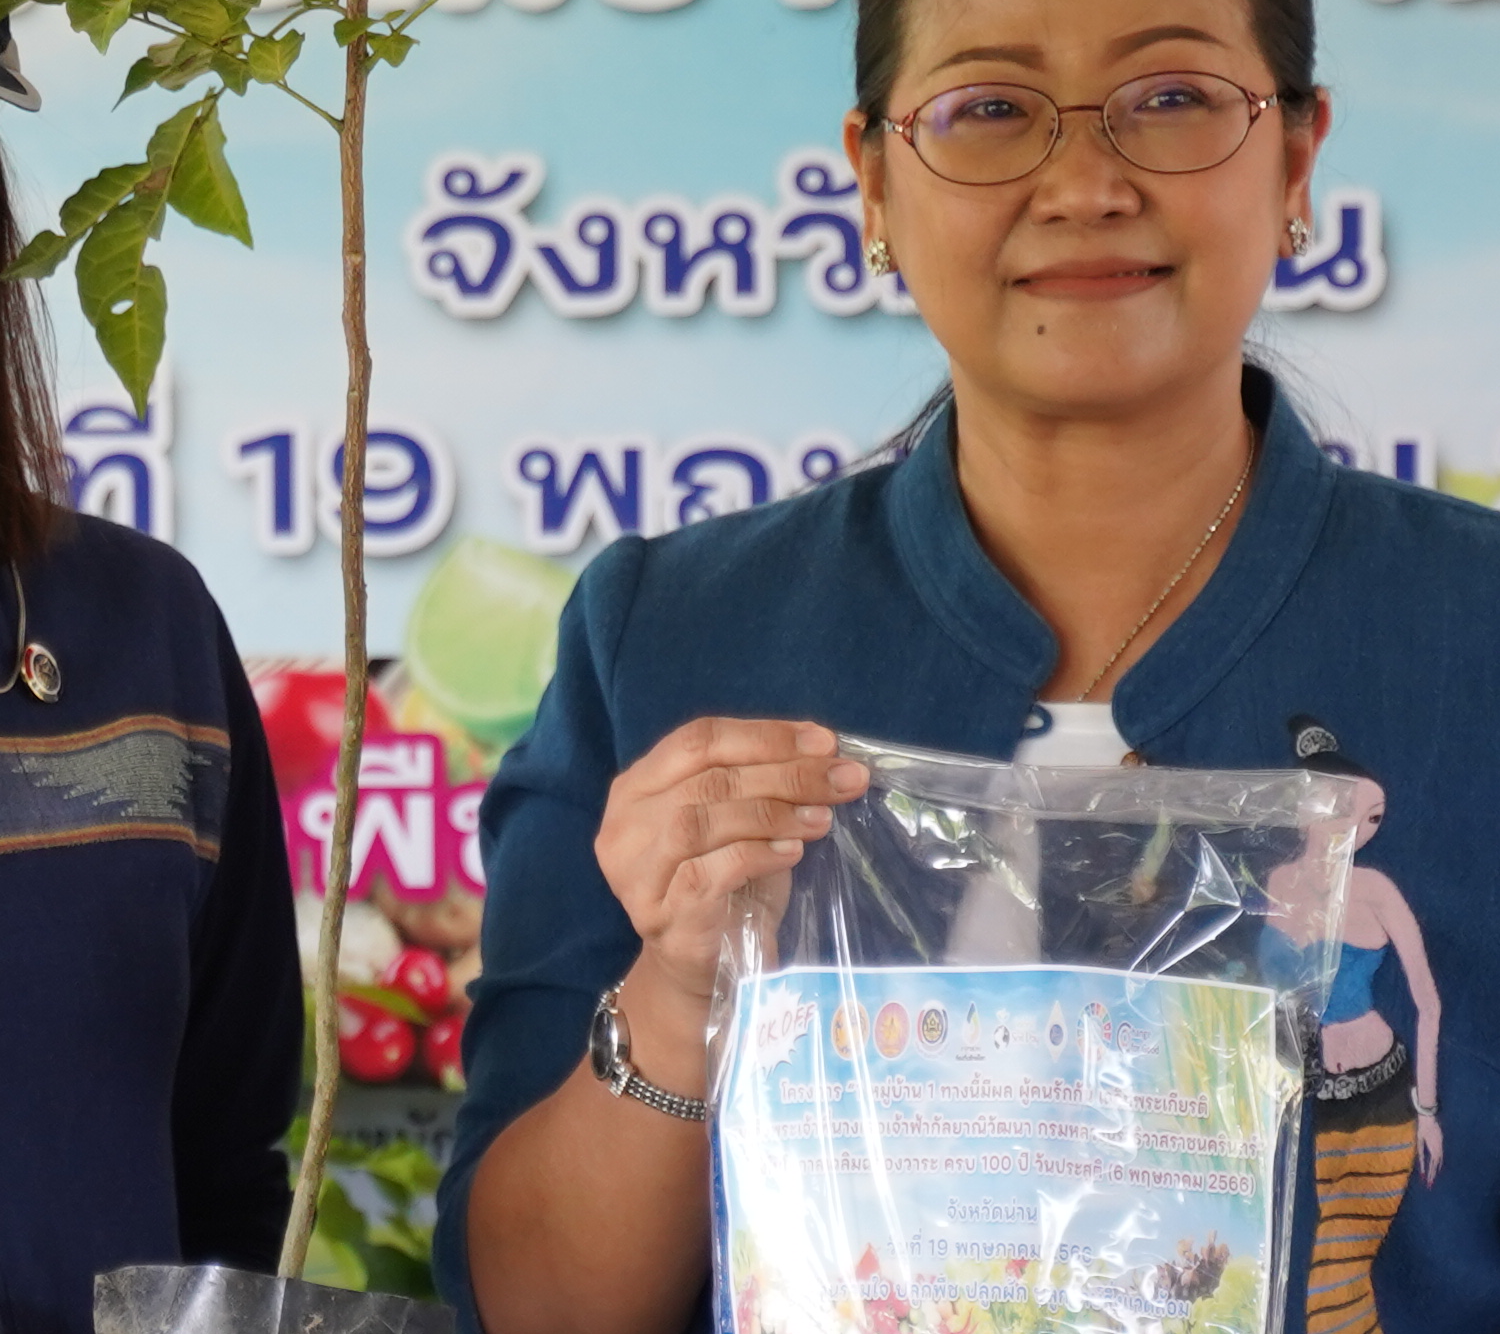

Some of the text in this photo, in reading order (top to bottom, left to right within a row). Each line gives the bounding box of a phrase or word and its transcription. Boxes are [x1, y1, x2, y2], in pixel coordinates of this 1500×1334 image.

[237, 429, 432, 536] 19
[928, 1082, 936, 1099] 1
[944, 1155, 976, 1173] ครบ
[981, 1154, 1012, 1172] 100
[1018, 1152, 1030, 1173] ปี
[1208, 1172, 1256, 1197] 2566)
[947, 1197, 1039, 1221] จังหวัดน่าน
[928, 1238, 948, 1257] 19
[955, 1239, 1042, 1262] พฤษภาคม
[965, 1277, 1028, 1309] ปลูกผัก
